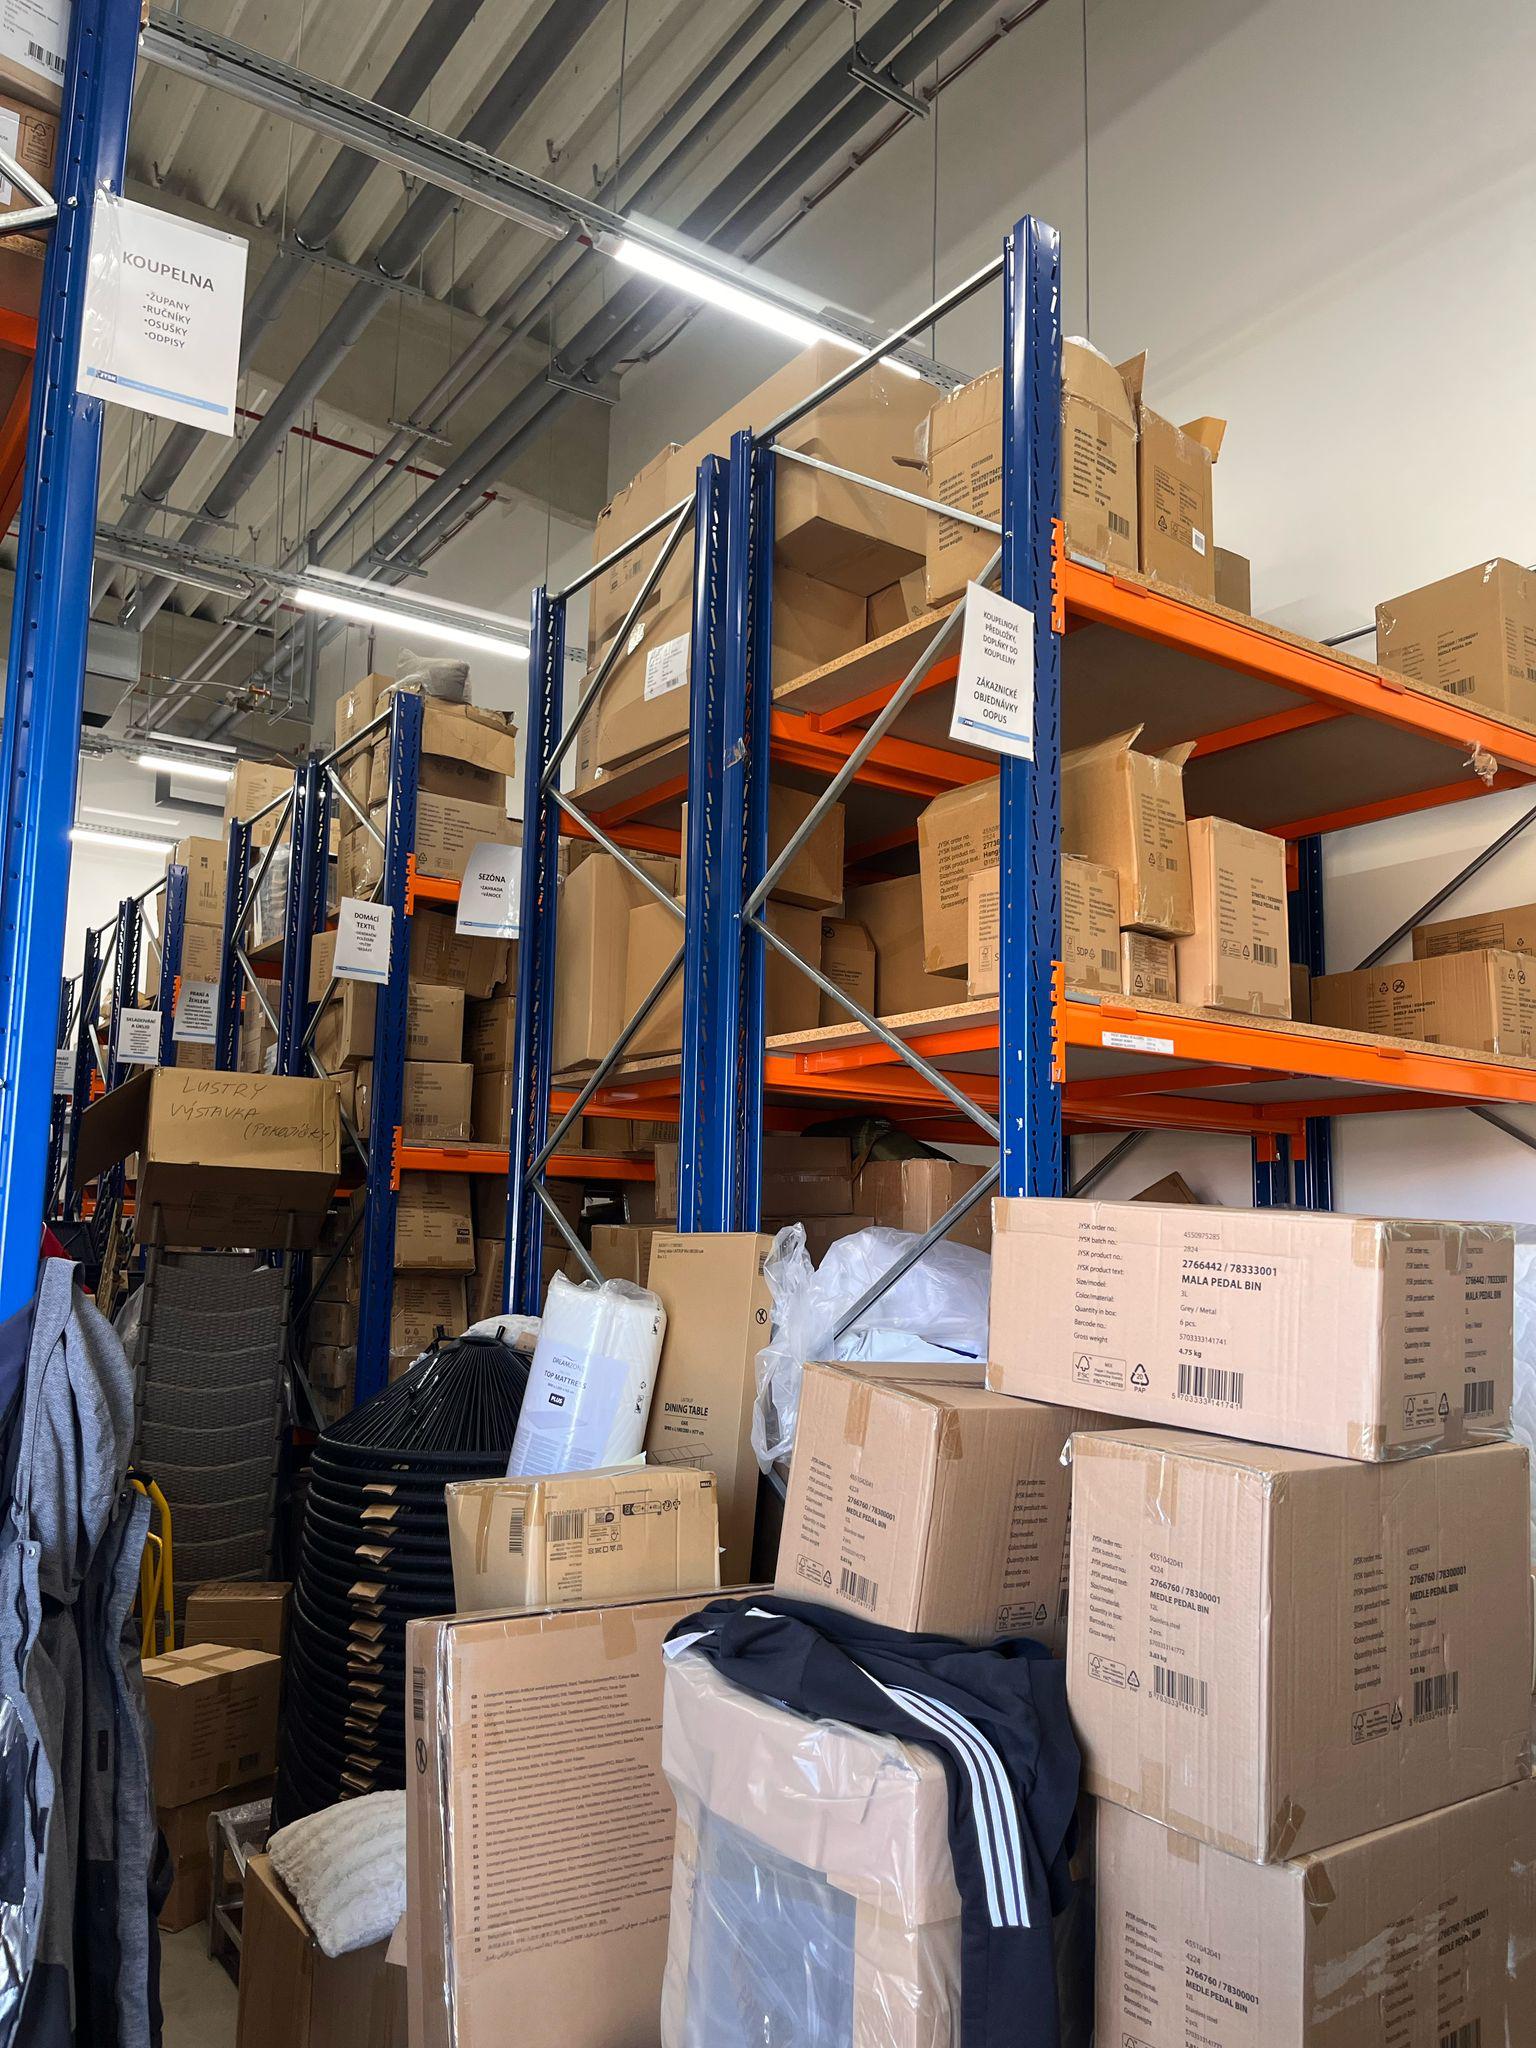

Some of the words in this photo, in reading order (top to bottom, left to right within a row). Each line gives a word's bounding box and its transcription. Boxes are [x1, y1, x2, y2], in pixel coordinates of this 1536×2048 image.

[122, 251, 215, 292] KOUPELNA
[976, 675, 1018, 699] ZÁKAZNICKÉ
[973, 690, 1019, 714] OBJEDNÁVKY
[982, 708, 1008, 724] OOPUS
[478, 872, 506, 883] SEZÓNA
[182, 1075, 267, 1100] LUSTRY
[171, 1101, 260, 1121] VÝSTAVKA
[1090, 1251, 1112, 1260] product
[1090, 1265, 1112, 1275] product
[1182, 1259, 1222, 1272] 2766442
[1230, 1263, 1277, 1277] 78333001
[1181, 1274, 1209, 1286] MALA
[1211, 1277, 1242, 1290] PEDAL
[1244, 1280, 1262, 1291] BIN
[1180, 1304, 1194, 1314] Grey
[1199, 1306, 1217, 1315] Metal
[1089, 1335, 1109, 1344] weight
[1193, 1349, 1202, 1359] kg
[544, 1369, 554, 1379] TOP
[555, 1373, 587, 1389] MATTRES
[664, 1402, 688, 1413] DINING
[689, 1405, 709, 1416] TABLE
[1409, 1573, 1436, 1586] 2766760
[1150, 1577, 1180, 1593] 2766760
[1185, 1587, 1221, 1604] 78300001
[1409, 1588, 1430, 1601] MEDLE
[1430, 1585, 1449, 1598] PEDAL
[1449, 1582, 1459, 1594] BIN
[1149, 1590, 1173, 1605] MEDLE
[1173, 1597, 1196, 1612] PEDAL
[1197, 1603, 1210, 1615] BIN
[1185, 1966, 1217, 1987] 2766760
[1222, 1982, 1260, 2005] 78300001
[1185, 1979, 1209, 1997] MEDLE
[1210, 1990, 1233, 2008] PEDAL
[1234, 2001, 1248, 2014] BIN
